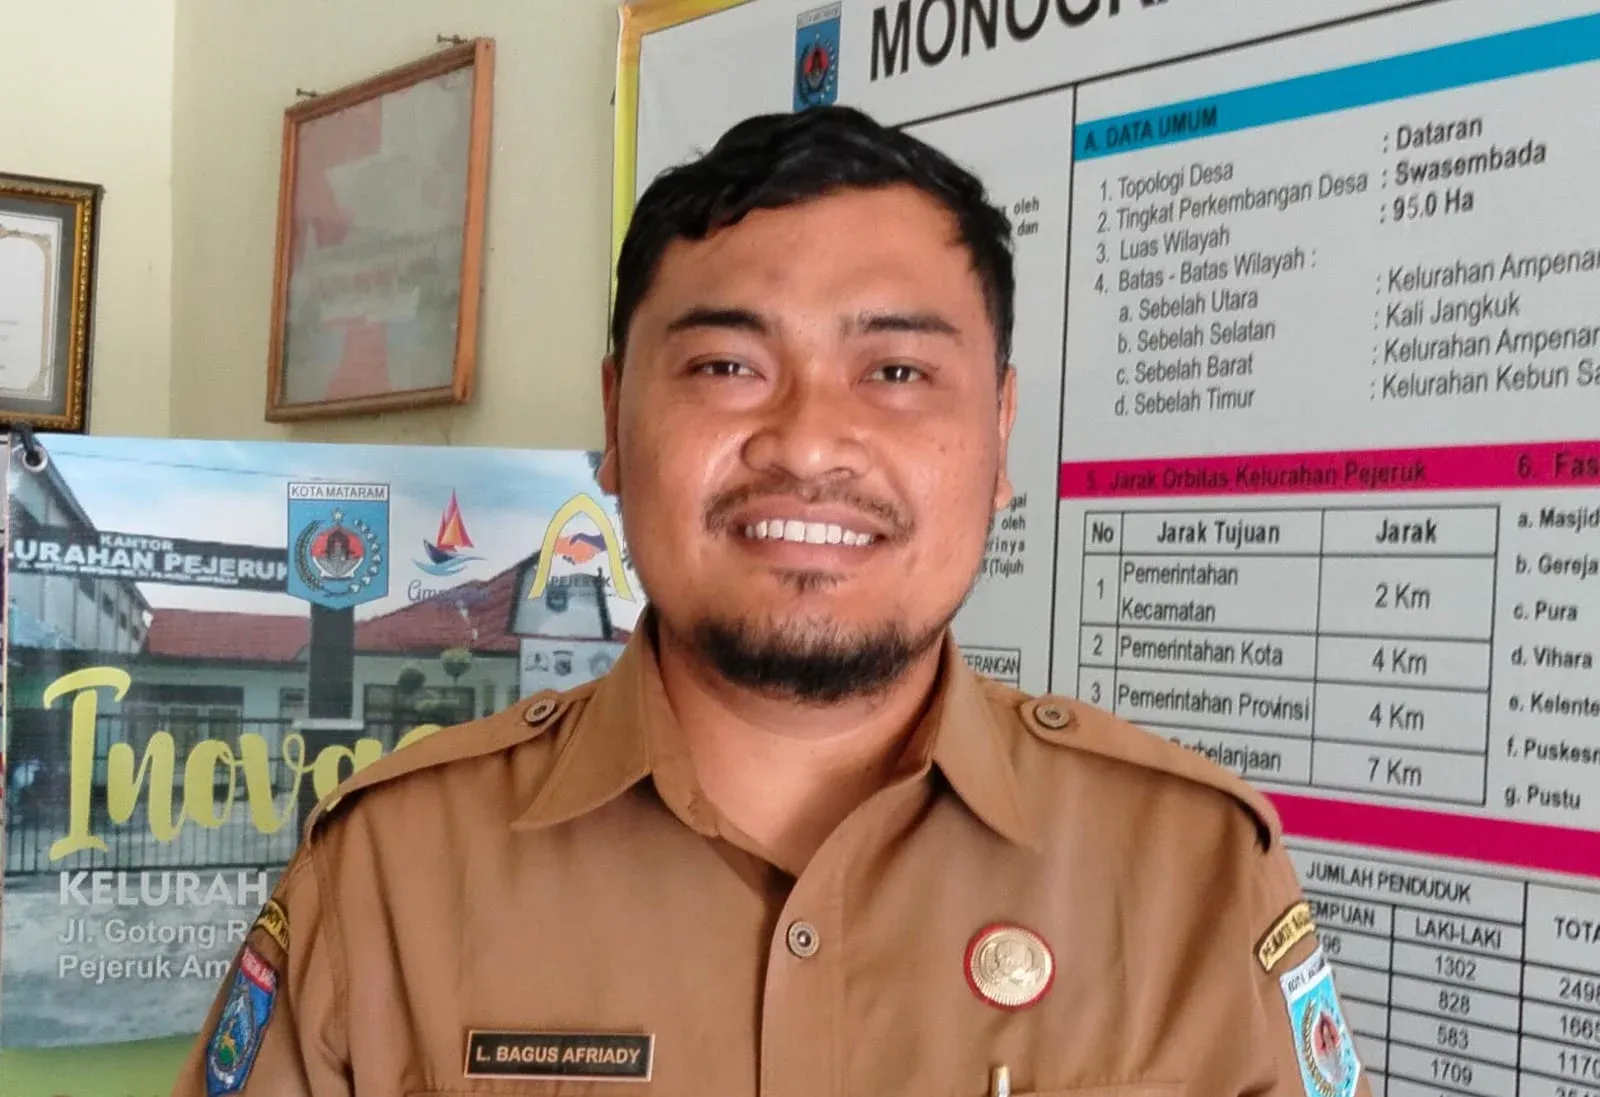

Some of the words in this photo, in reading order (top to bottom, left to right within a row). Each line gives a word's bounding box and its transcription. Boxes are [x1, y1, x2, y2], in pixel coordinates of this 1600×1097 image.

[869, 0, 1170, 82] MONO
[1106, 116, 1154, 147] DATA
[1158, 105, 1218, 140] UMUM
[1100, 181, 1111, 202] 1.
[1118, 167, 1185, 201] Topologi
[1190, 161, 1234, 190] Desa
[1397, 115, 1482, 151] Dataran
[1097, 210, 1111, 233] 2.
[1116, 204, 1174, 233] Tingkat
[1179, 181, 1312, 219] Perkembangan
[1319, 171, 1368, 200] Desa
[1395, 140, 1547, 187] Swasembada
[1013, 195, 1040, 216] oleh
[1017, 219, 1039, 237] dan
[1095, 241, 1110, 265] 3.
[1120, 237, 1158, 262] Luas
[1163, 226, 1230, 257] Wilayah
[1392, 192, 1436, 222] 95.0
[1444, 189, 1475, 216] Ha
[1094, 273, 1108, 295] 4.
[1119, 264, 1163, 292] Batas
[1180, 259, 1228, 286] Batas
[1234, 248, 1305, 282] Wilayah
[1119, 304, 1133, 324] a.
[1138, 293, 1205, 321] Sebelah
[1211, 288, 1258, 314] Utara
[1388, 258, 1495, 294] Kelurahan
[1500, 247, 1600, 284] Ampena
[1117, 333, 1131, 355] b.
[1136, 326, 1204, 354] Sebelah
[1209, 319, 1276, 347] Selatan
[1385, 300, 1424, 330] Kali
[1429, 290, 1520, 328] Jangkuk
[1116, 367, 1130, 385] c.
[1134, 359, 1201, 386] Sebelah
[1206, 355, 1253, 381] Barat
[1384, 331, 1491, 365] Kelurahan
[1114, 393, 1130, 417] d.
[1133, 389, 1201, 417] Sebelah
[1206, 386, 1254, 411] Timur
[1382, 368, 1488, 400] Kelurahan
[1495, 362, 1569, 392] Kebun
[1110, 468, 1156, 492] Jarak
[1162, 463, 1228, 490] Orbitas
[1235, 461, 1337, 488] Kelurahan
[1344, 460, 1426, 489] Pejeruk
[1517, 453, 1534, 479] 6.
[1554, 451, 1600, 479] Fas
[290, 485, 324, 500] KOTA
[326, 485, 386, 500] MATARAM
[1001, 514, 1025, 531] oleh
[1375, 519, 1437, 546] Jarak
[1517, 512, 1533, 528] a.
[1539, 505, 1600, 534] Masjid
[101, 534, 174, 552] KANTOR
[1092, 522, 1114, 546] No
[1157, 520, 1207, 546] Jarak
[1214, 520, 1280, 550] Tujuan
[1122, 562, 1239, 587] Pemerintahan
[1515, 552, 1531, 574] b.
[1538, 552, 1599, 580] Gereja
[1096, 579, 1105, 600] 1
[1375, 585, 1388, 609] 2
[1395, 586, 1431, 611] Km
[1121, 600, 1216, 624] Kecamatan
[1513, 603, 1528, 620] c.
[1534, 600, 1578, 621] Pura
[1092, 636, 1103, 657] 2
[1120, 638, 1235, 665] Pemerintahan
[1240, 641, 1283, 668] Kota
[1511, 646, 1526, 666] d.
[1533, 646, 1593, 669] Vihara
[964, 654, 1019, 677] ERANGAN
[1372, 650, 1386, 674] 4
[1391, 651, 1428, 676] Km
[1091, 683, 1101, 704] 3
[1117, 687, 1233, 715] Pemerintahan
[1238, 696, 1310, 723] Provinsi
[1508, 694, 1523, 713] e.
[1368, 706, 1382, 729] 4
[1388, 707, 1425, 733] Km
[1169, 736, 1281, 773] belanjaan
[1506, 735, 1517, 758] f.
[43, 666, 447, 862] Inova
[1367, 758, 1381, 782] 7
[1387, 762, 1422, 787] Km
[1504, 785, 1519, 808] g.
[1527, 784, 1581, 810] Pustu
[59, 869, 268, 907] KELURAH
[1305, 860, 1373, 892] JUMLAH
[1376, 868, 1471, 905] PENDUDUK
[58, 918, 93, 944] Jl.
[105, 919, 217, 950] Gotong
[1415, 916, 1502, 949] LAKI-LAKI
[59, 954, 171, 984] Pejeruk
[1433, 955, 1477, 981] 1302
[1438, 990, 1471, 1015] 828
[1437, 1025, 1469, 1050] 583
[475, 1045, 491, 1062] L.
[496, 1045, 558, 1063] BAGUS
[562, 1046, 641, 1065] AFRIADY
[1431, 1058, 1473, 1086] 1709
